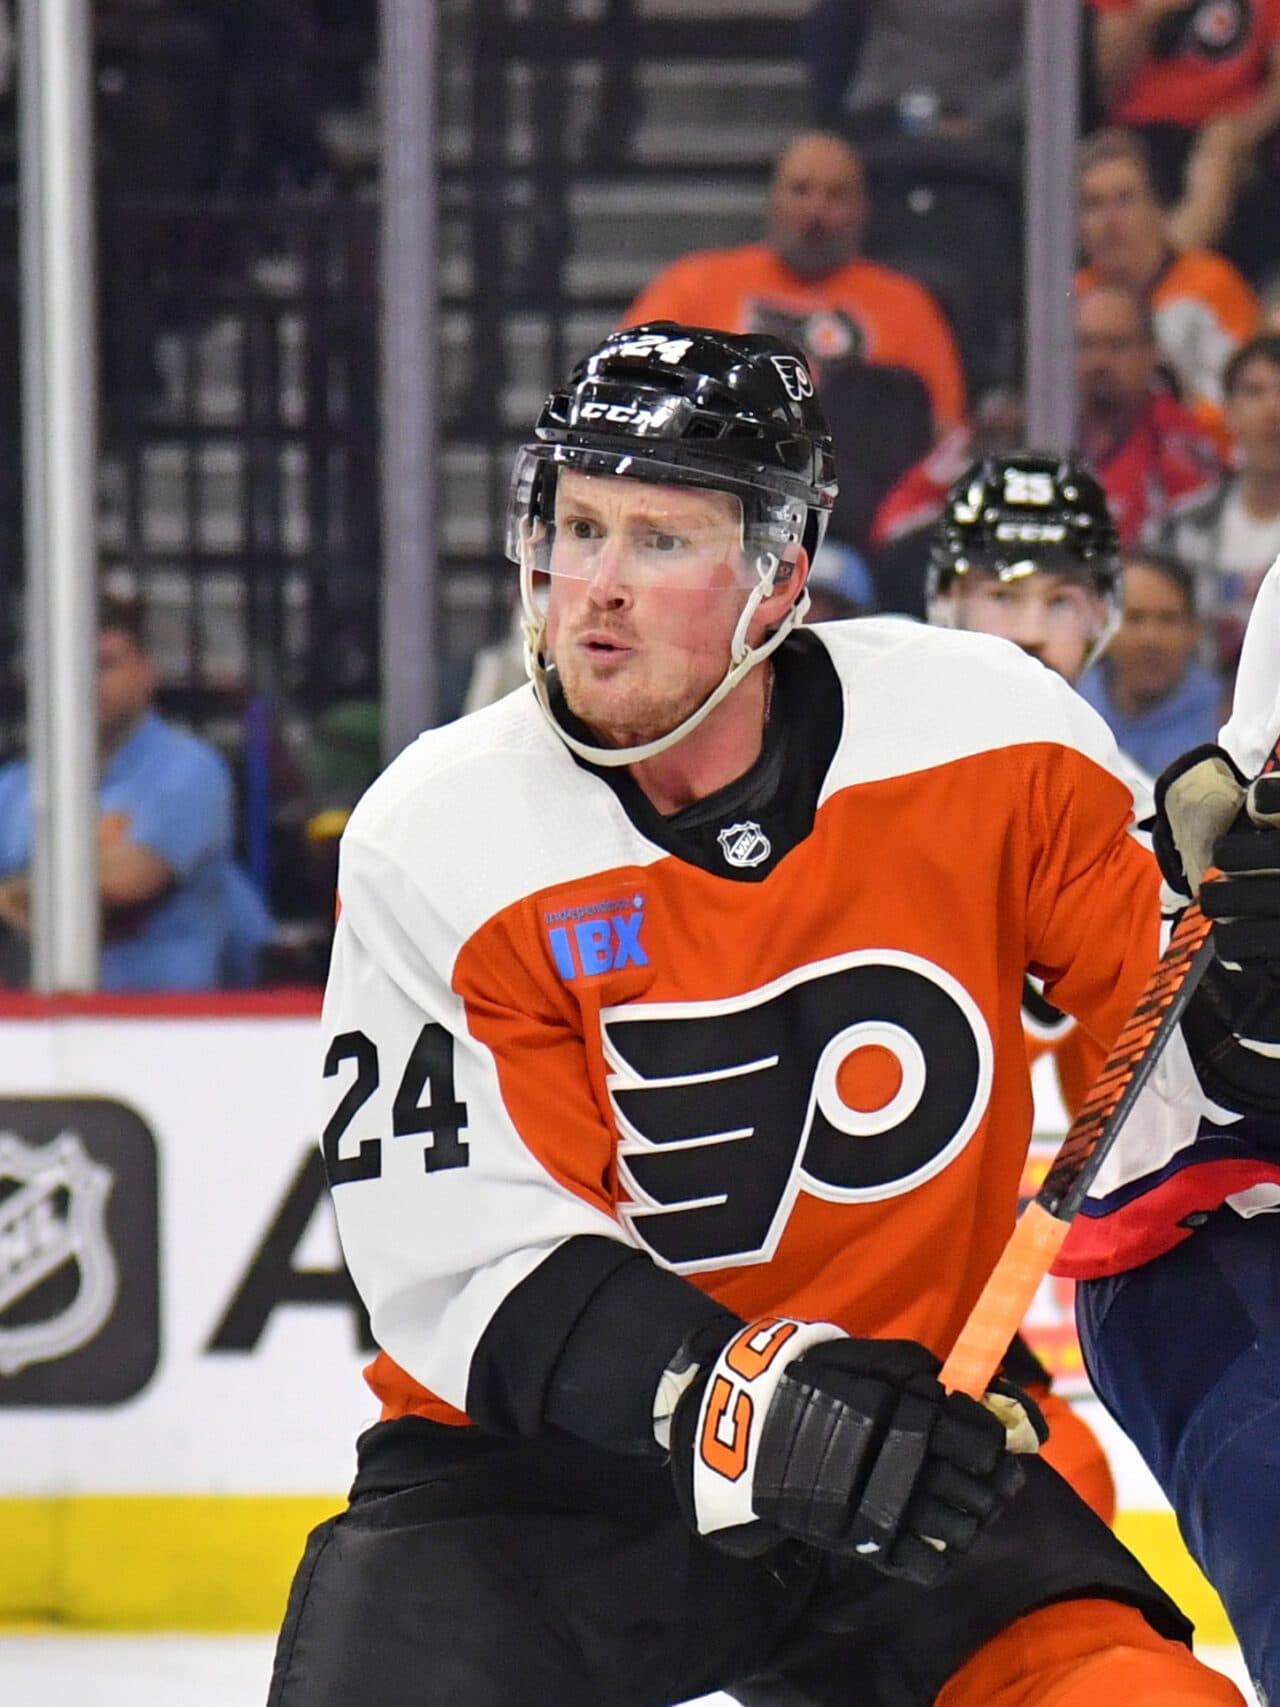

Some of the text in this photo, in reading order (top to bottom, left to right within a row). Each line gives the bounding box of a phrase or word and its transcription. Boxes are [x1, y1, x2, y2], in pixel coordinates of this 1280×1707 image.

[620, 334, 694, 364] 24
[548, 912, 649, 979] IBX
[323, 1022, 469, 1187] 24
